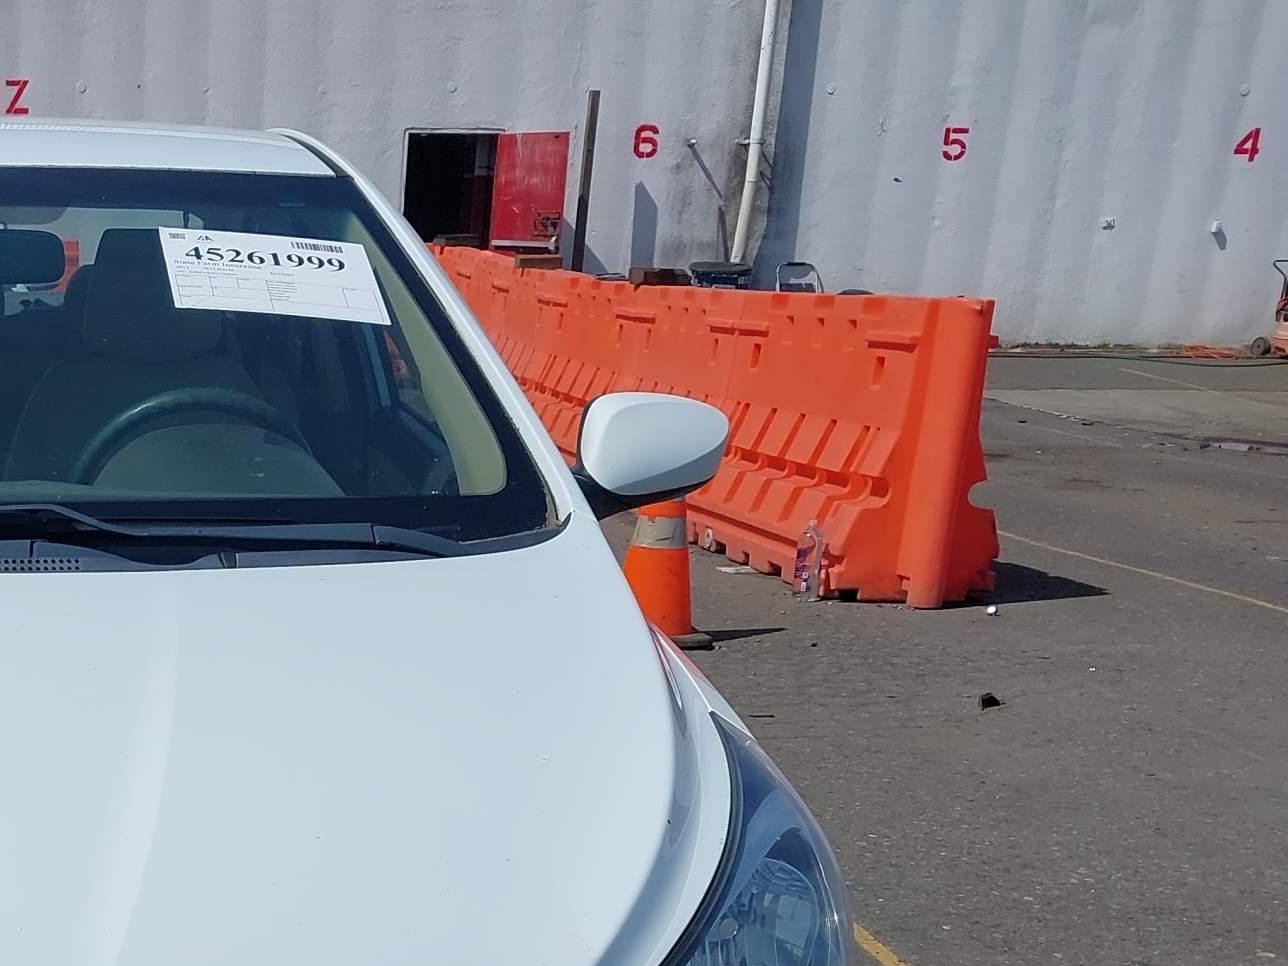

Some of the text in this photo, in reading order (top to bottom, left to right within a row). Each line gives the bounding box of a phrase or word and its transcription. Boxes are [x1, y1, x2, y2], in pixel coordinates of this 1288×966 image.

[633, 124, 659, 159] 6
[942, 127, 969, 161] 5
[1233, 127, 1261, 162] 4
[185, 246, 346, 272] 45261999
